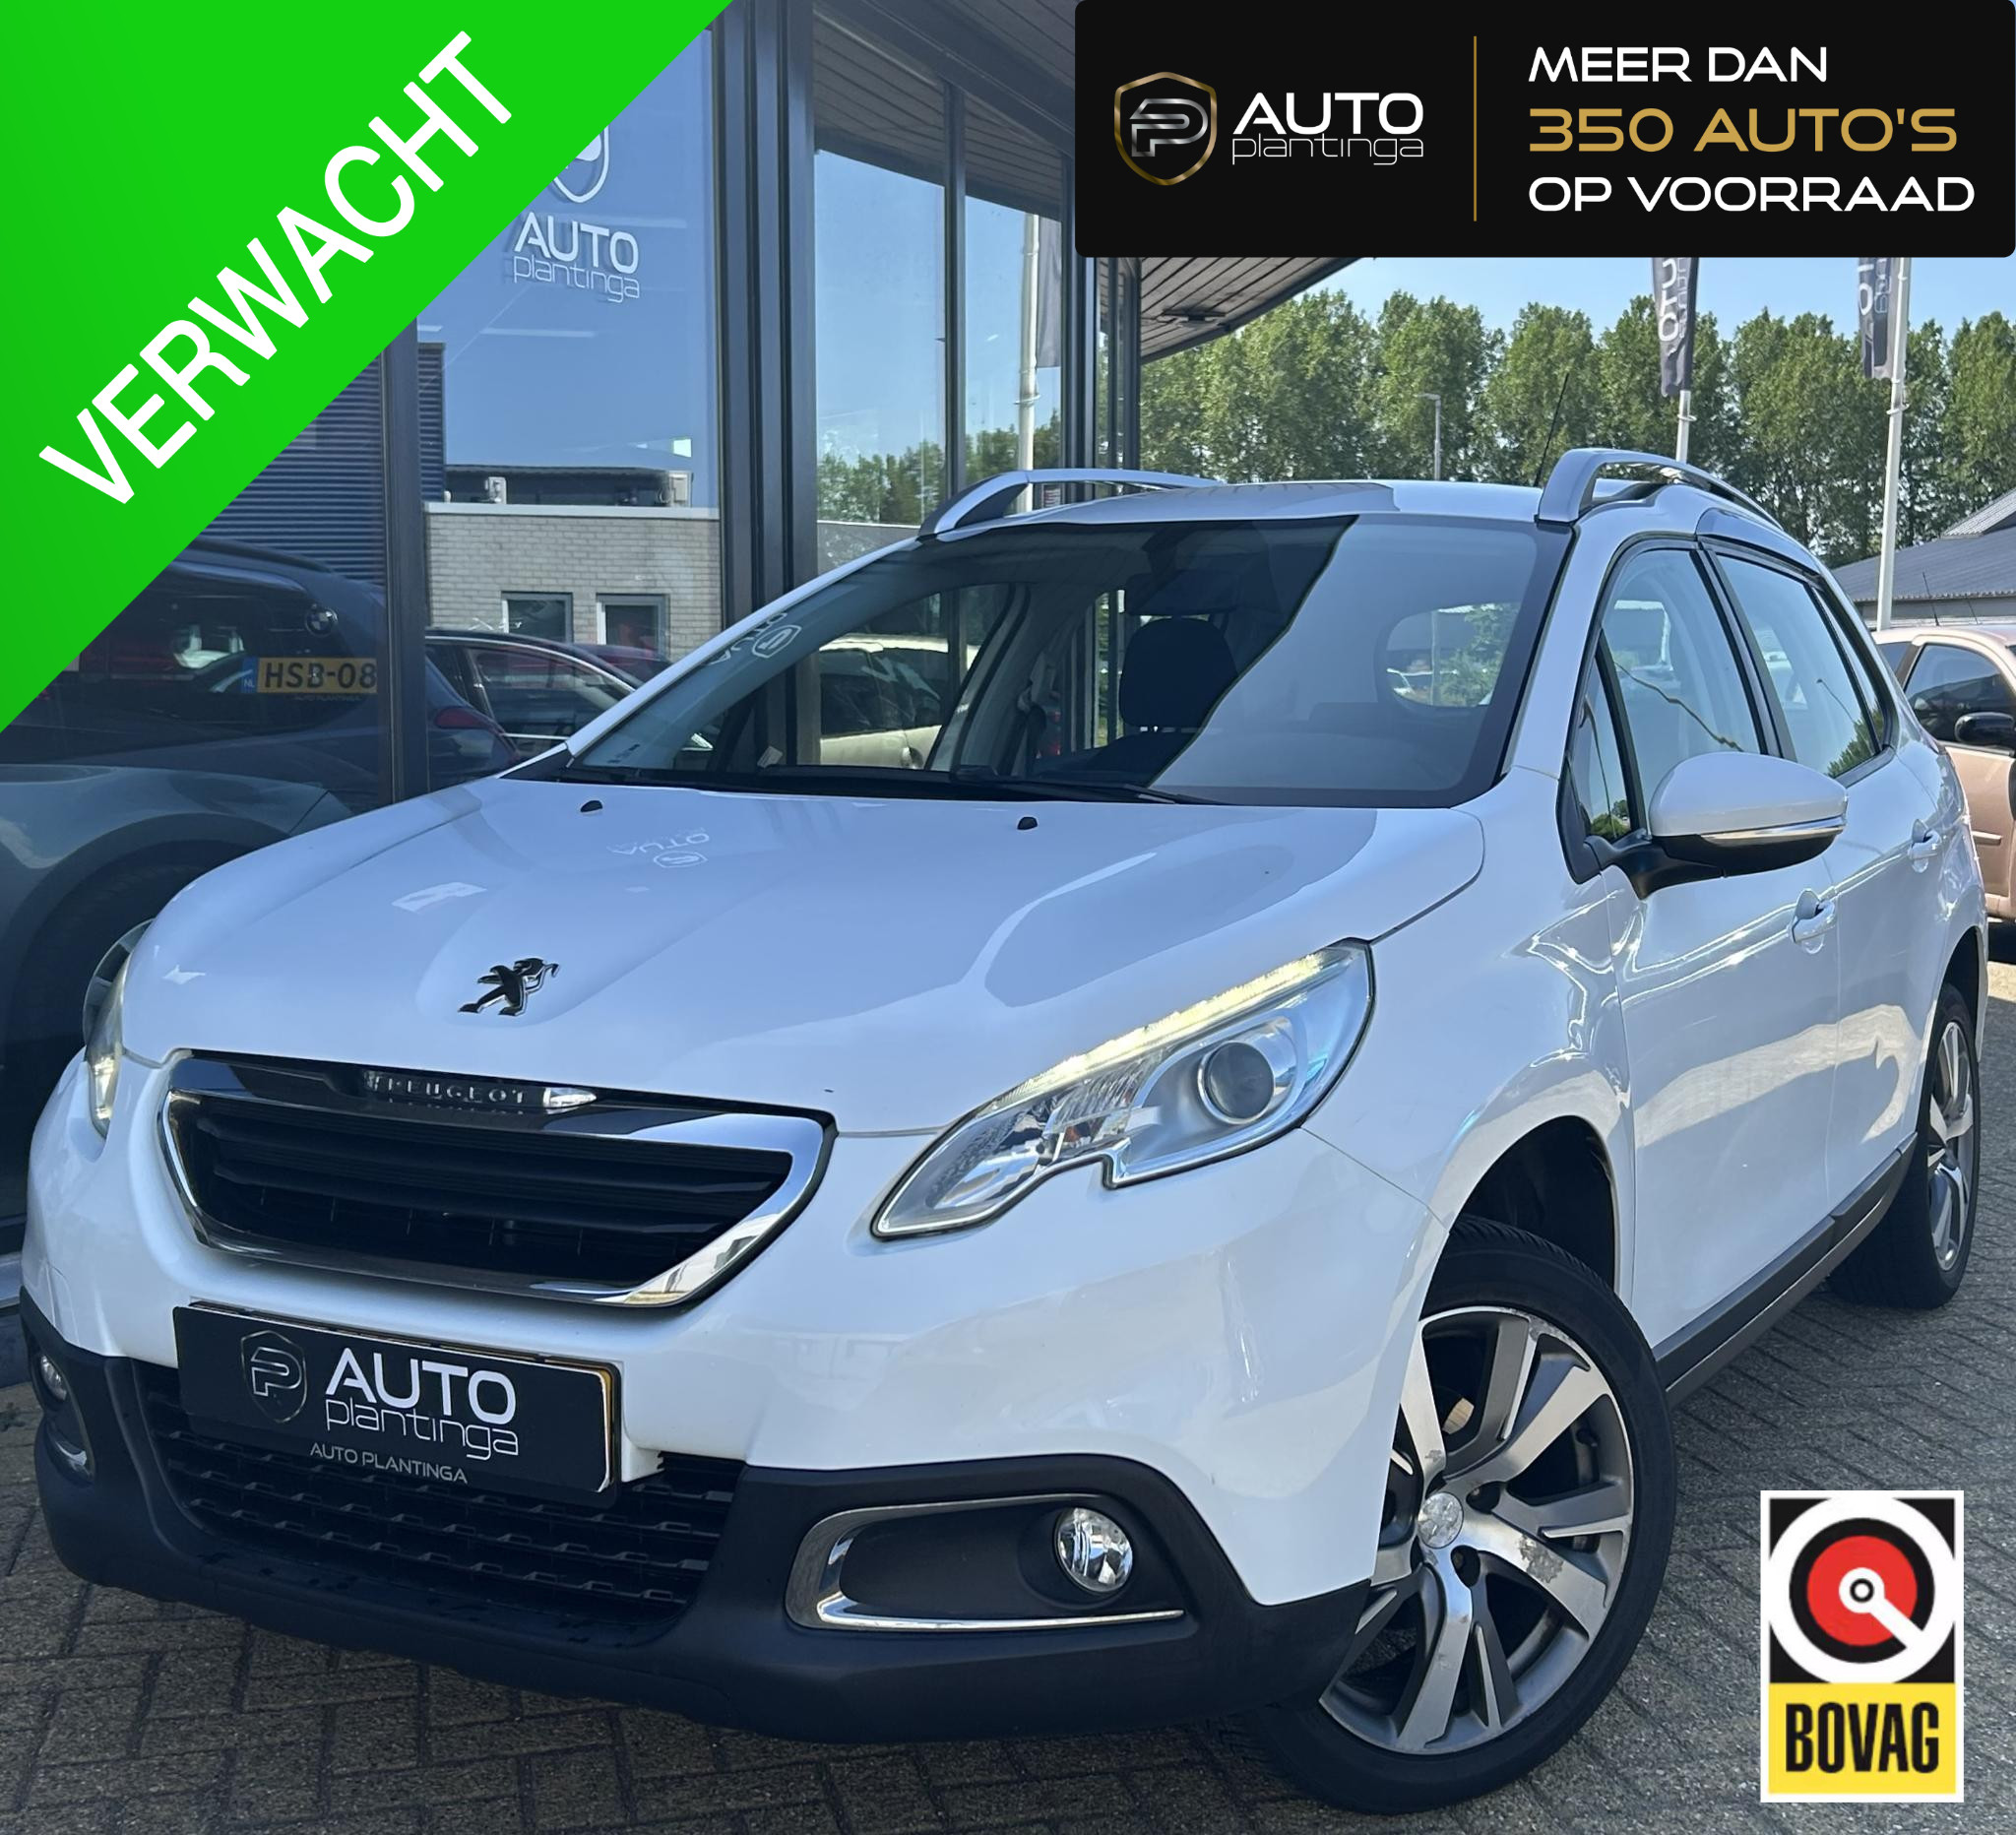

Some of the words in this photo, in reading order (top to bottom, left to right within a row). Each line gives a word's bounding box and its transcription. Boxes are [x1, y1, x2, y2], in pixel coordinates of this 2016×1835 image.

[514, 212, 639, 274] AUTO
[514, 254, 640, 303] plantinga
[388, 1077, 525, 1105] PEUGEOT
[325, 1348, 517, 1425] AUTO
[325, 1397, 519, 1461] plantinga
[310, 1442, 358, 1464] AUTO
[362, 1451, 468, 1485] PLANTINGA
